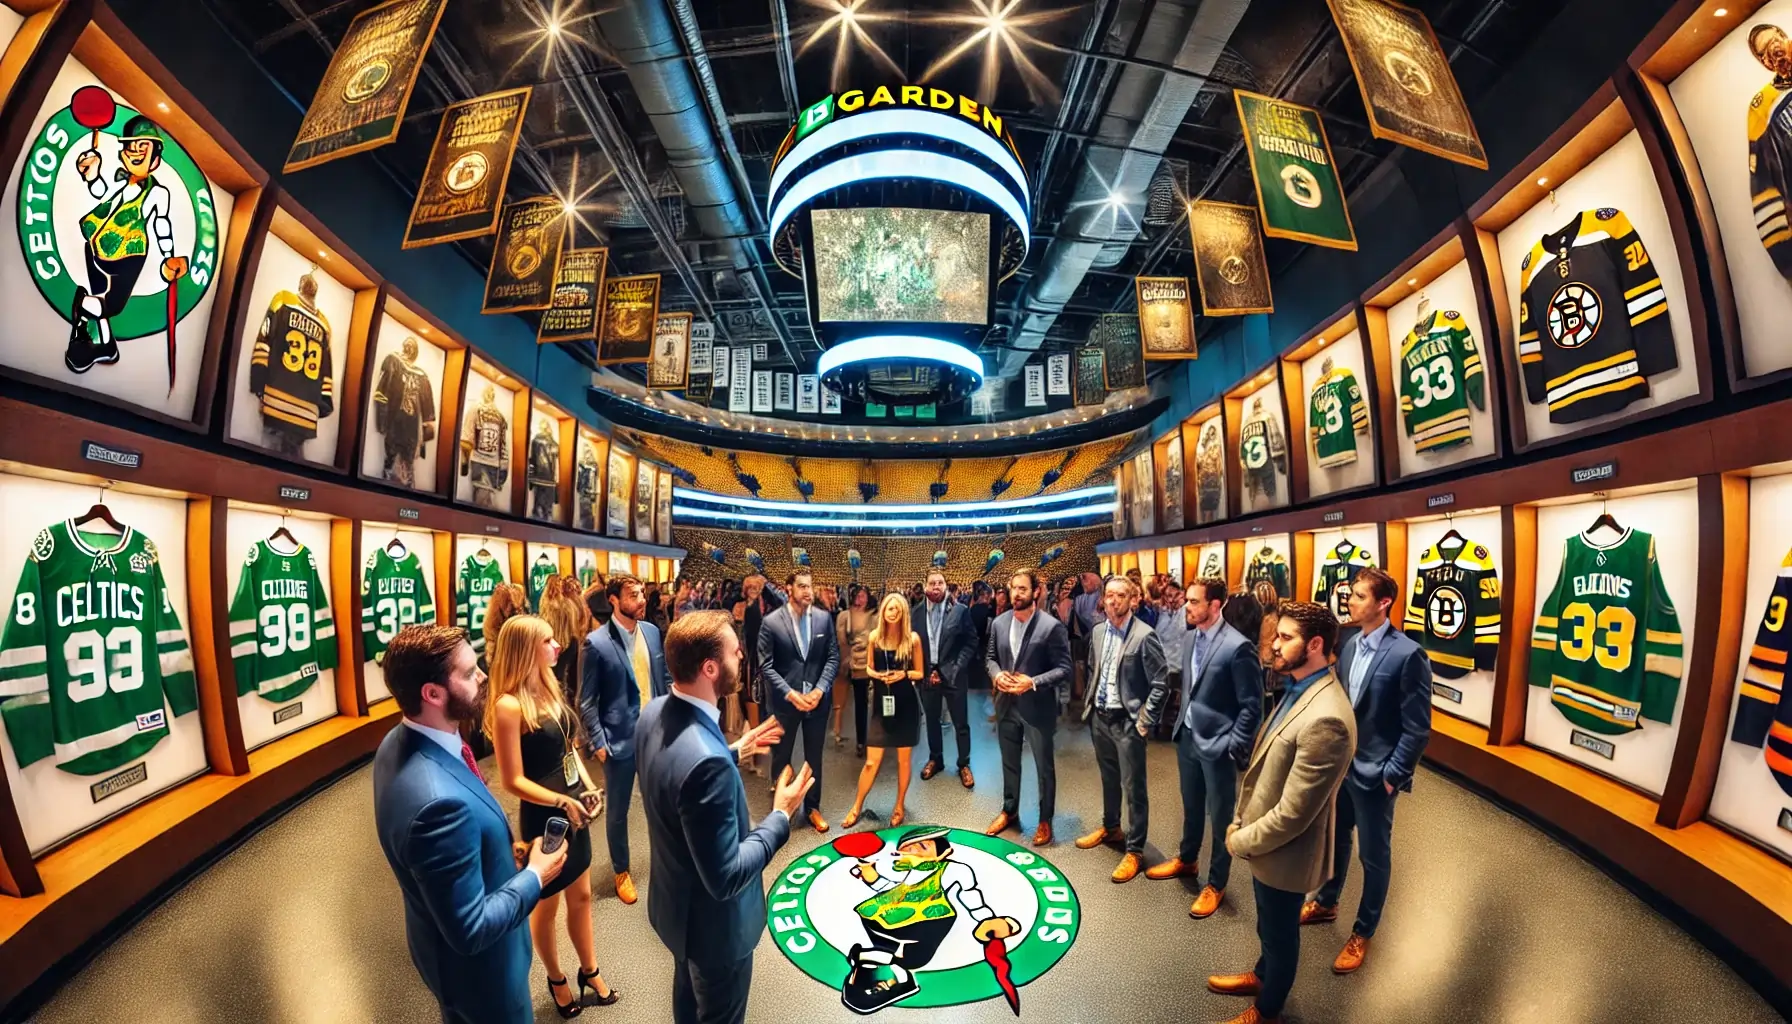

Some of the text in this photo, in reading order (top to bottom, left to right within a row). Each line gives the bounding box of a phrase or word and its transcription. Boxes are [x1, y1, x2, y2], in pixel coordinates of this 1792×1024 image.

[837, 85, 1002, 137] GARDEN
[1410, 355, 1455, 408] 33
[56, 581, 145, 627] CELTICS
[63, 625, 145, 702] 93
[1560, 602, 1636, 672] 33
